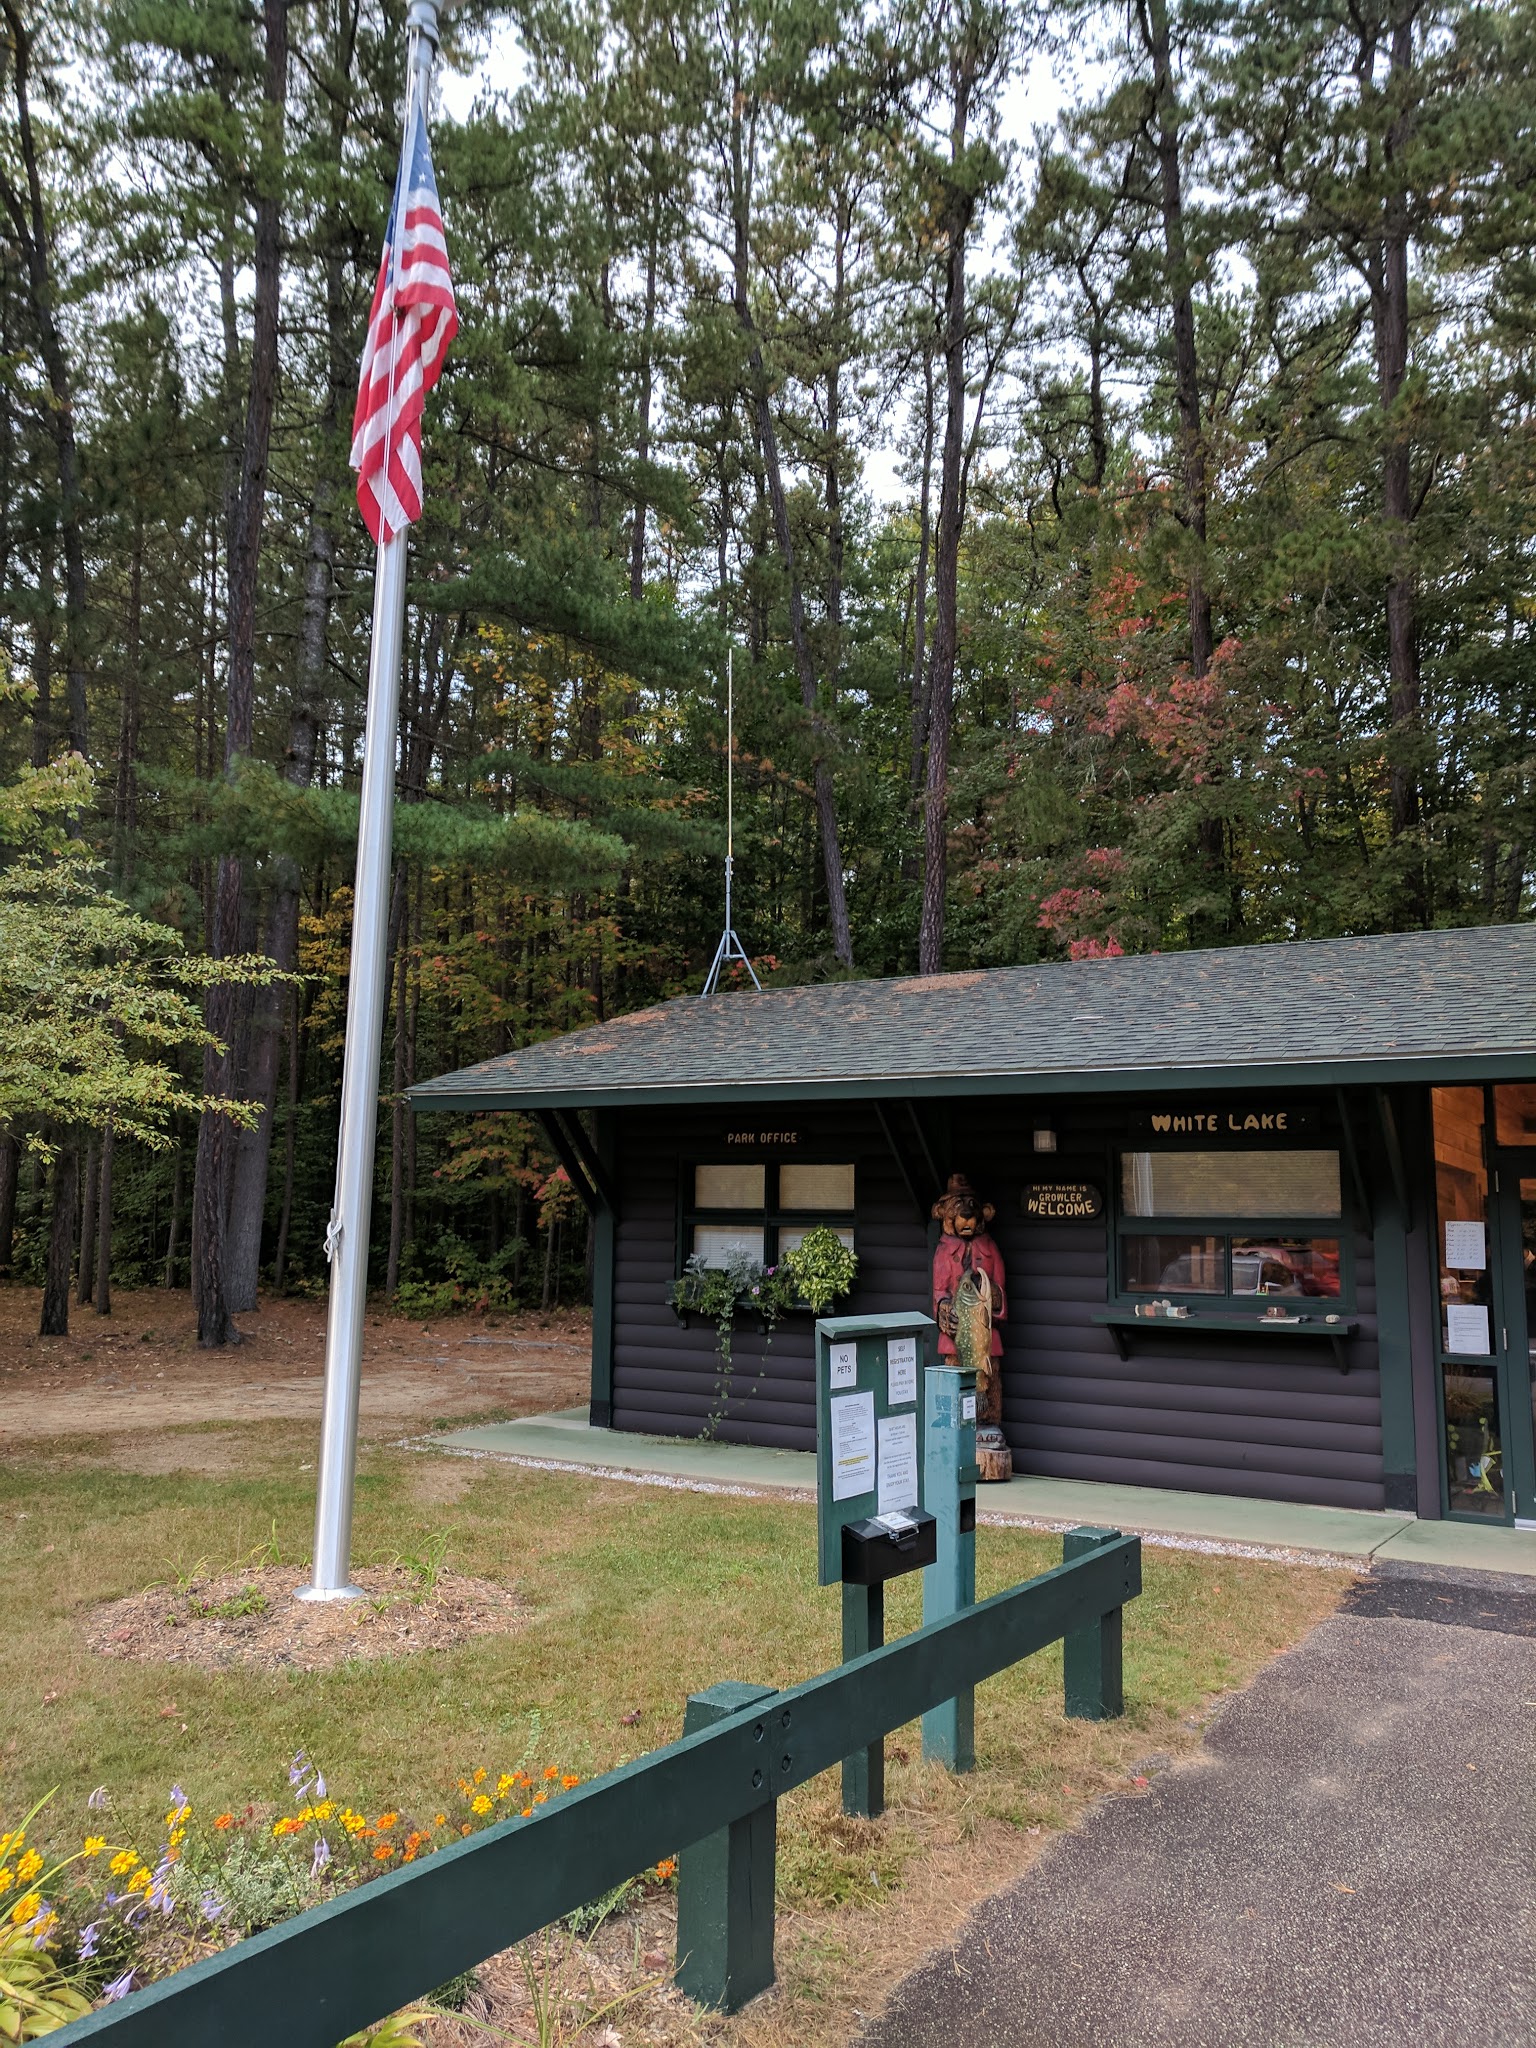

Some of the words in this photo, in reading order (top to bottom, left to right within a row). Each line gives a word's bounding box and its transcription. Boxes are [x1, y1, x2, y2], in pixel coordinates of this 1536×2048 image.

[1151, 1114, 1218, 1132] WHITE
[1228, 1113, 1287, 1130] LAKE
[727, 1132, 755, 1143] PARK
[760, 1132, 797, 1143] OFFICE
[1039, 1193, 1082, 1202] GROWLER
[1028, 1199, 1095, 1215] WELCOME
[840, 1354, 848, 1363] NO
[837, 1365, 851, 1374] PETS
